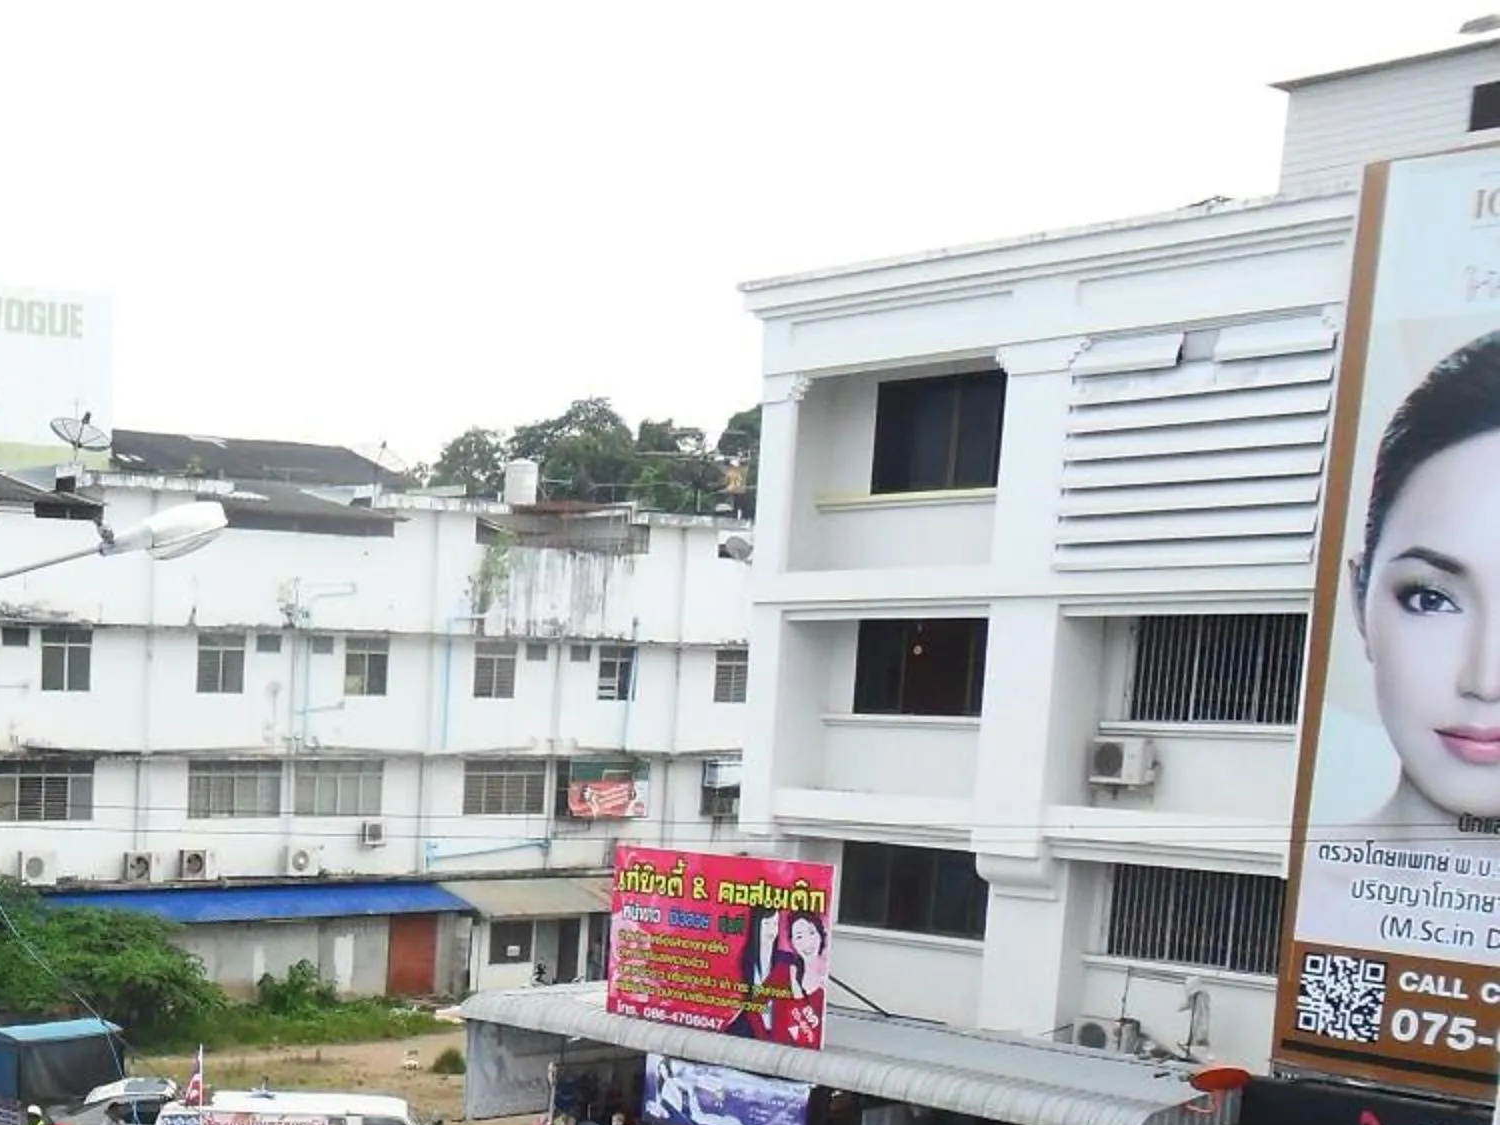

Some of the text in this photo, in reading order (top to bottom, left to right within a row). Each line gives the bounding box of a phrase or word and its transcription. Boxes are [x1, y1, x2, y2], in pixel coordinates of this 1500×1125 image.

[1318, 839, 1449, 872] ตรวจโดยแพทย์
[693, 875, 709, 899] &
[718, 879, 825, 914] คอสเมติก
[1351, 879, 1500, 914] ปริญญาโทวิทย
[1398, 971, 1470, 999] CALL
[1391, 1008, 1500, 1051] 075-
